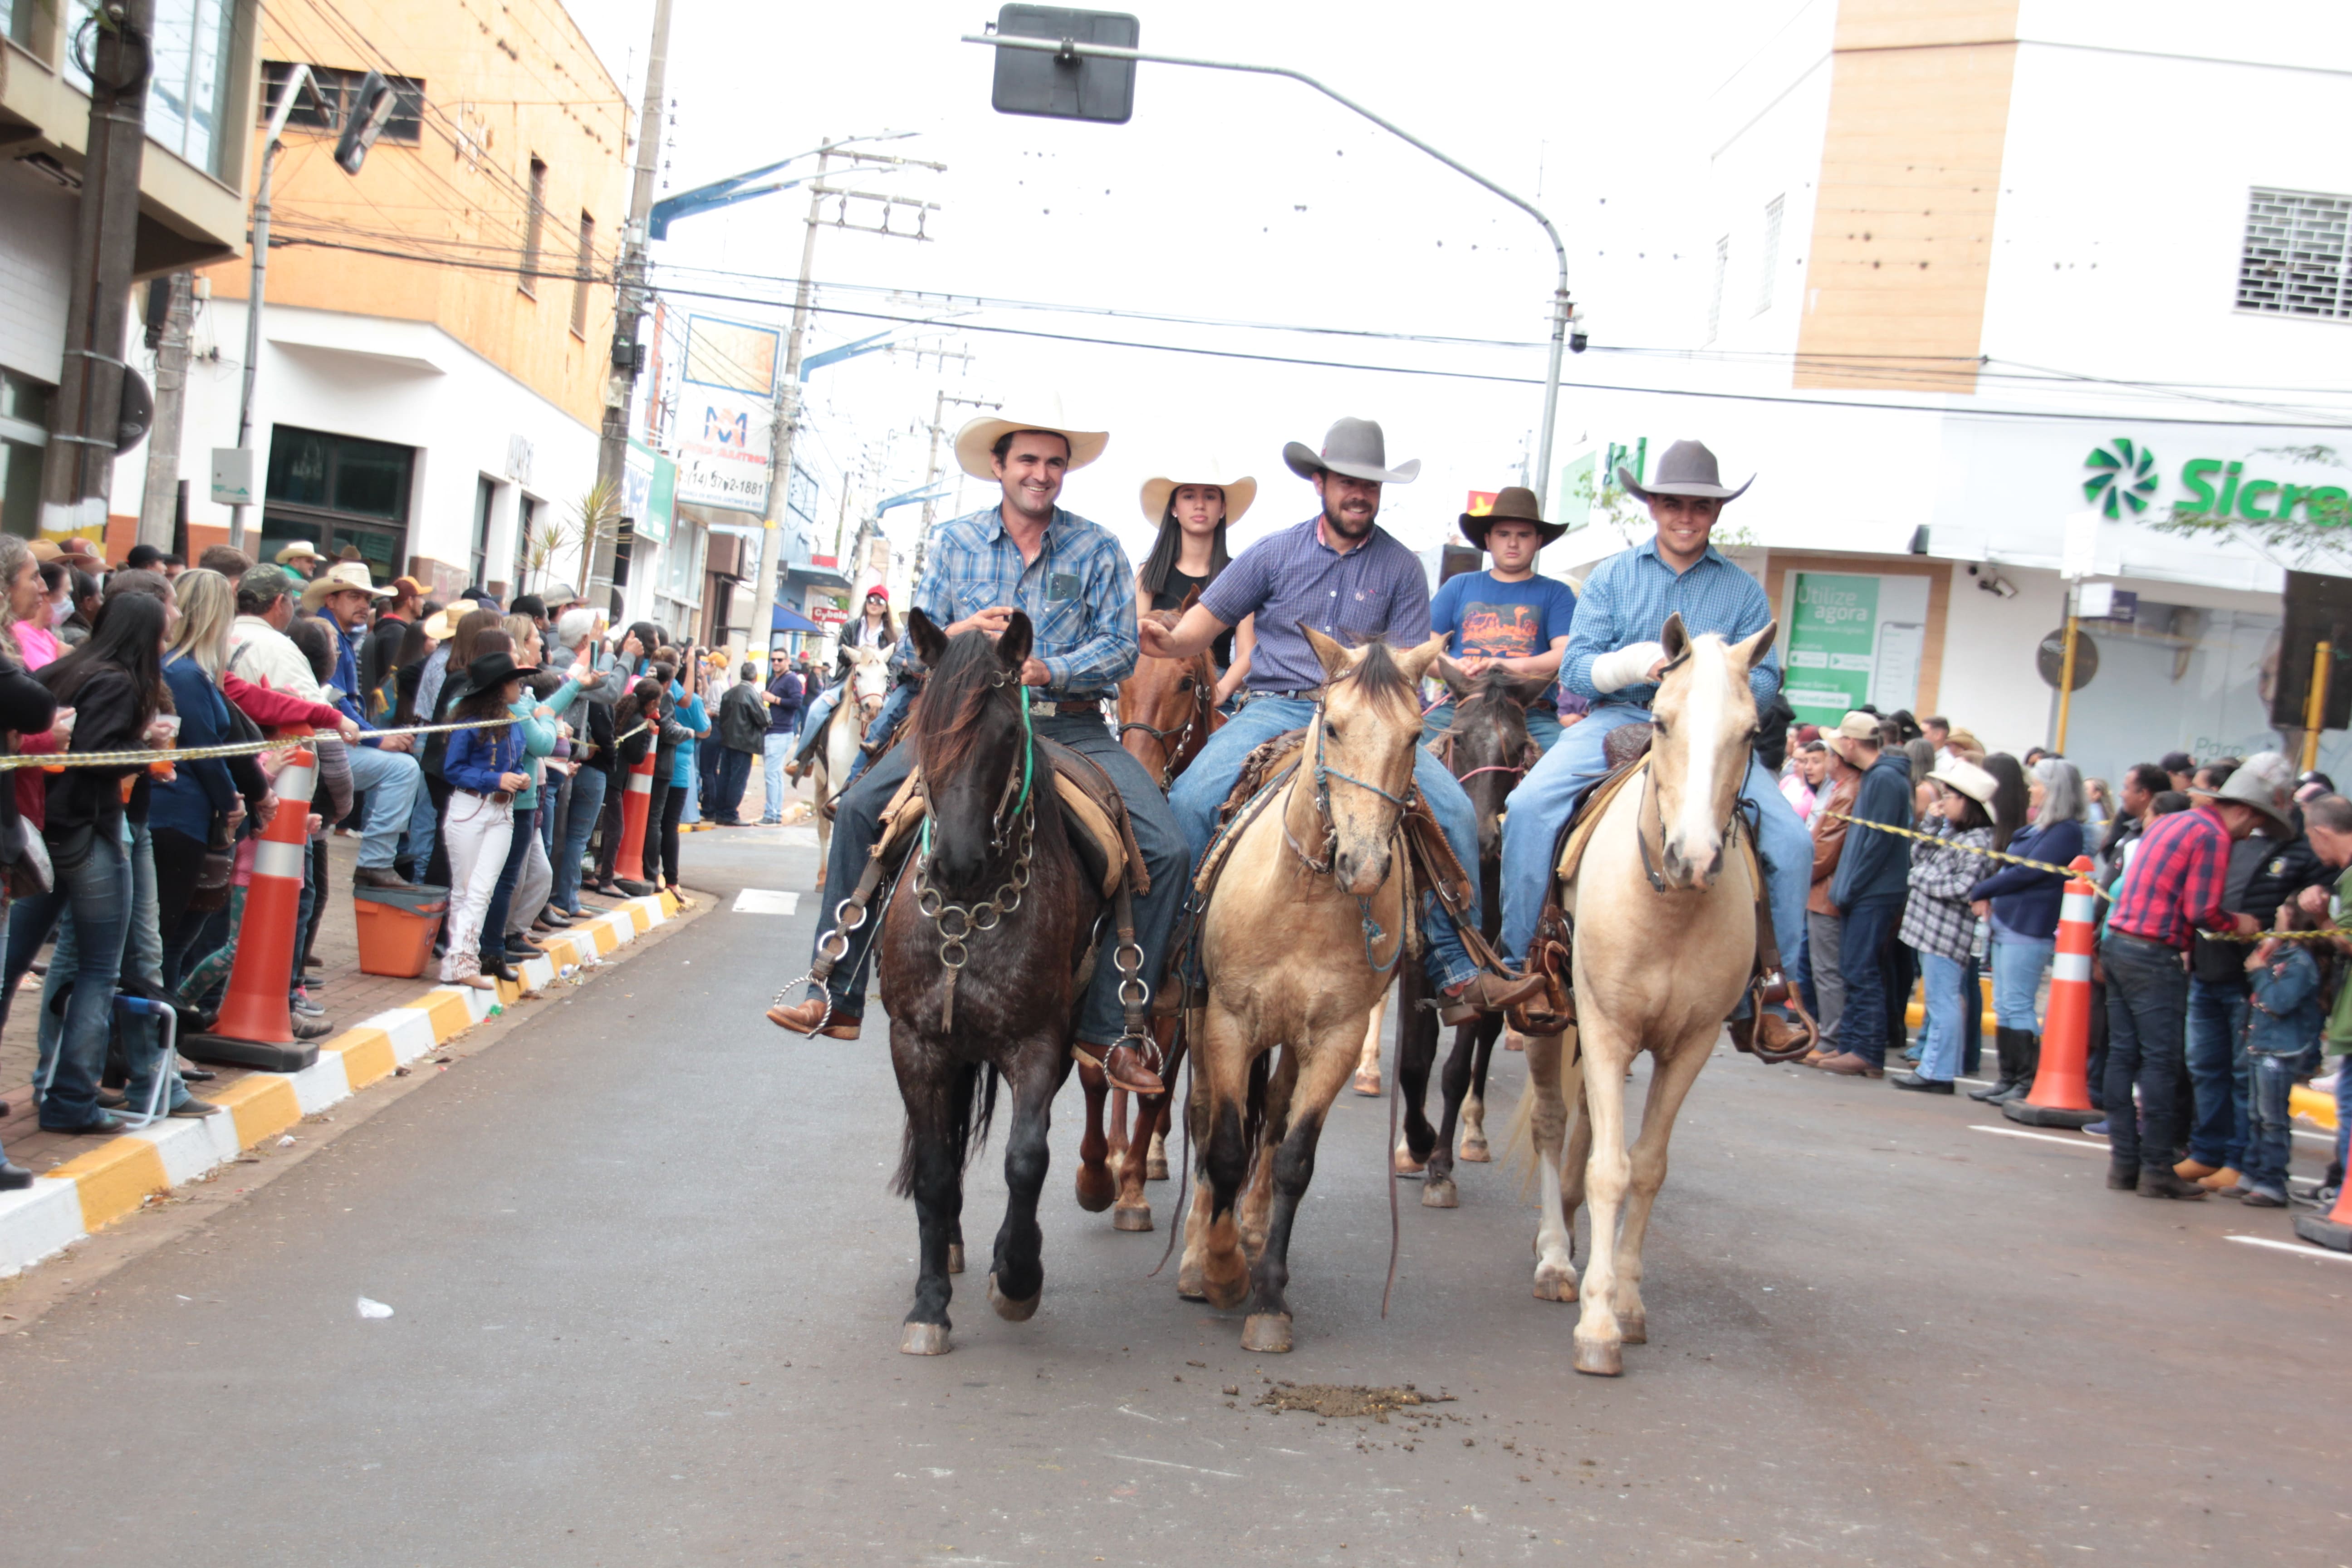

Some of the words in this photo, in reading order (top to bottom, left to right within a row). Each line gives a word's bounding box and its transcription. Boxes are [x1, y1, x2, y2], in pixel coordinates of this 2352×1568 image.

[710, 475, 764, 496] 372-1881
[2174, 458, 2352, 528] Sicre
[1798, 585, 1858, 606] Utilize
[1814, 606, 1869, 624] agora
